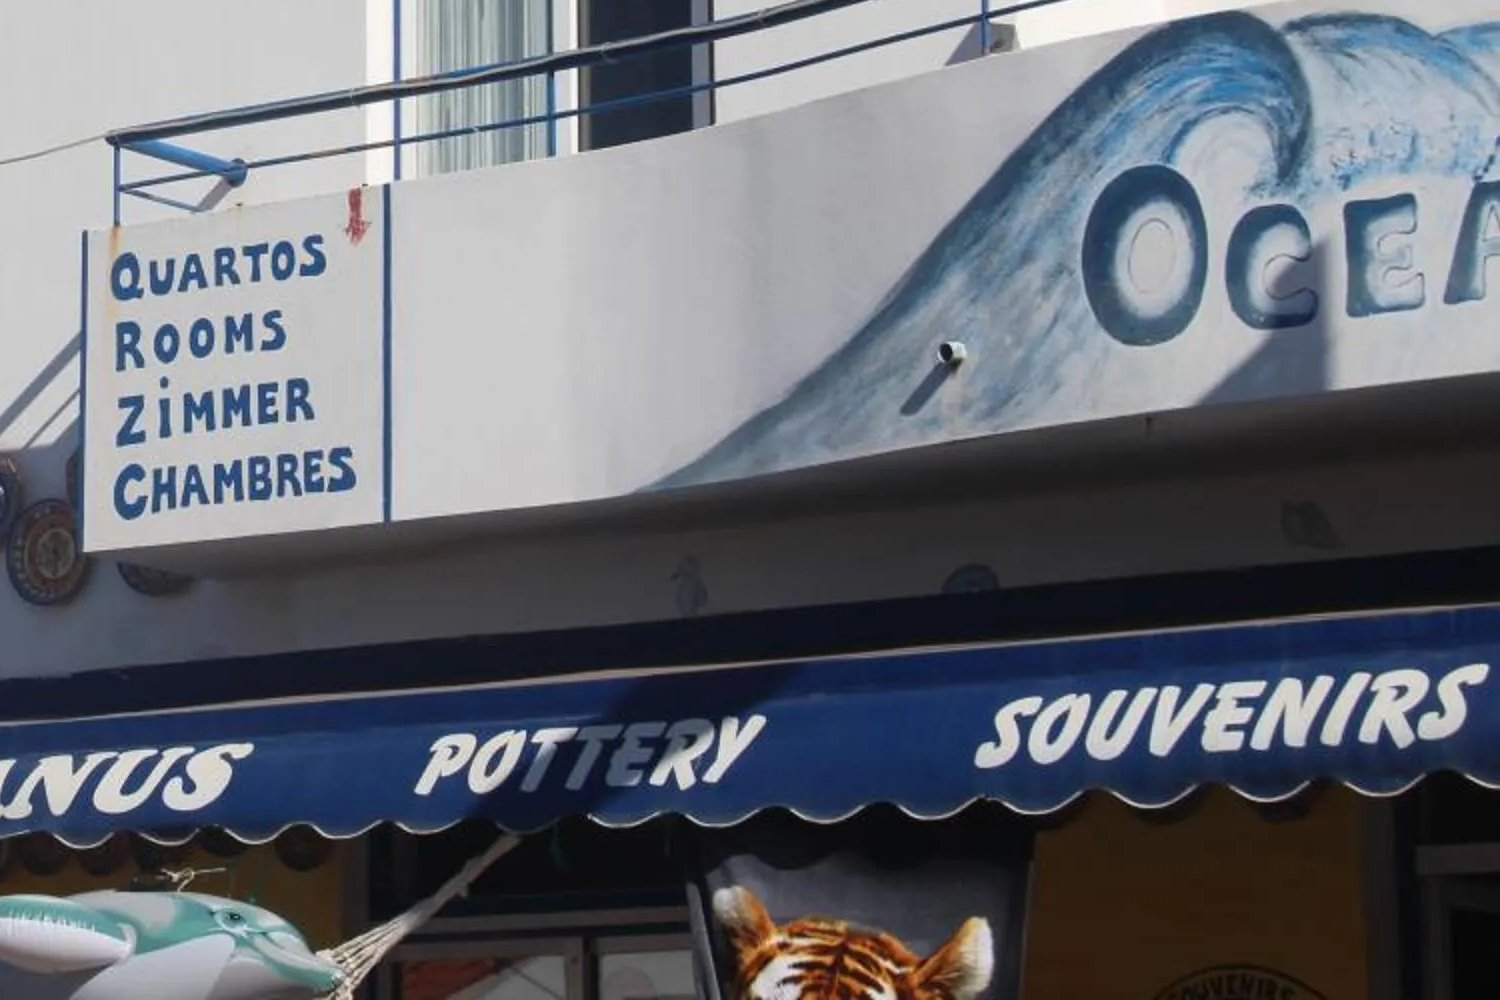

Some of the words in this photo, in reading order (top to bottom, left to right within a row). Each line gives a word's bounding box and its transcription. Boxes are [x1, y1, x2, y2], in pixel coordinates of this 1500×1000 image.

[110, 234, 326, 300] QUARTOS
[115, 310, 286, 371] ROOMS
[113, 446, 356, 520] CHAMBRES
[414, 714, 767, 796] POTTERY
[974, 663, 1489, 769] SOUVENIRS
